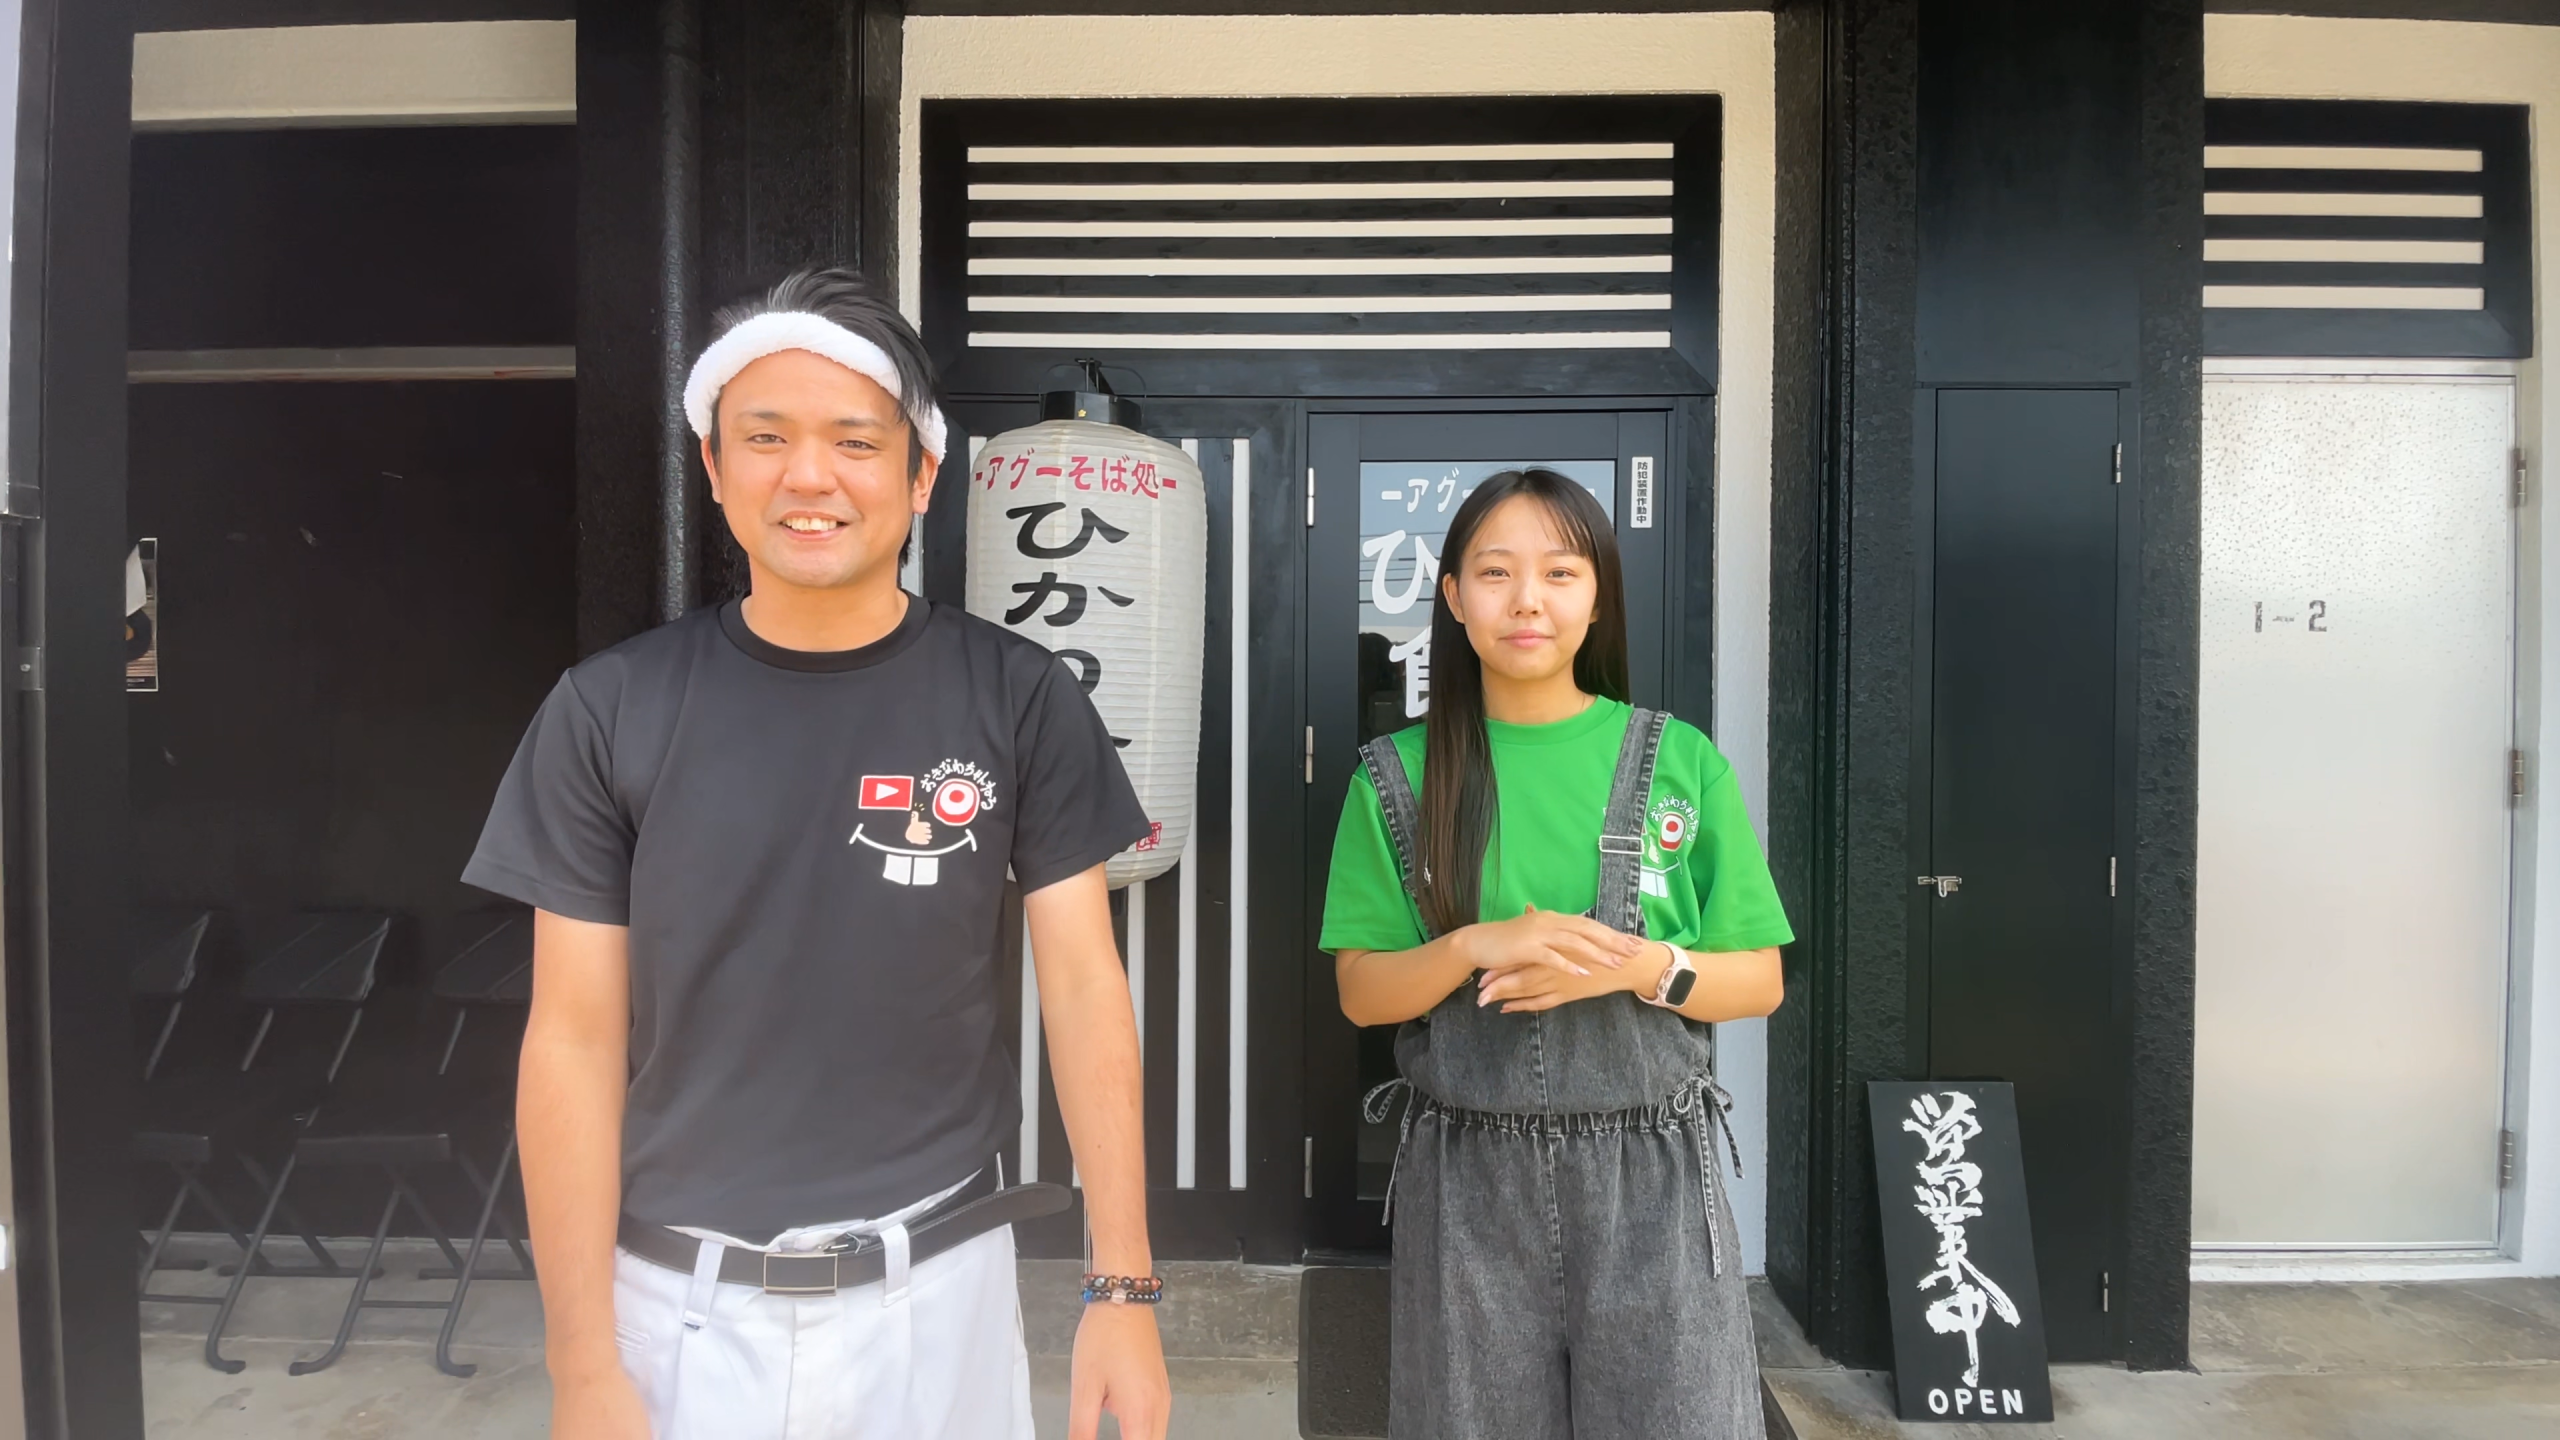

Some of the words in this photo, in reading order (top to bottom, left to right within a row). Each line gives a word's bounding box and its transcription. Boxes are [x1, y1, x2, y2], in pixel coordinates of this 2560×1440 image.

[1636, 461, 1648, 524] 防犯装置作動中
[2253, 600, 2327, 633] 1-2
[920, 758, 997, 810] おきなわちゃんねる
[1902, 1091, 2021, 1388] 営業中
[1928, 1388, 2024, 1416] OPEN
